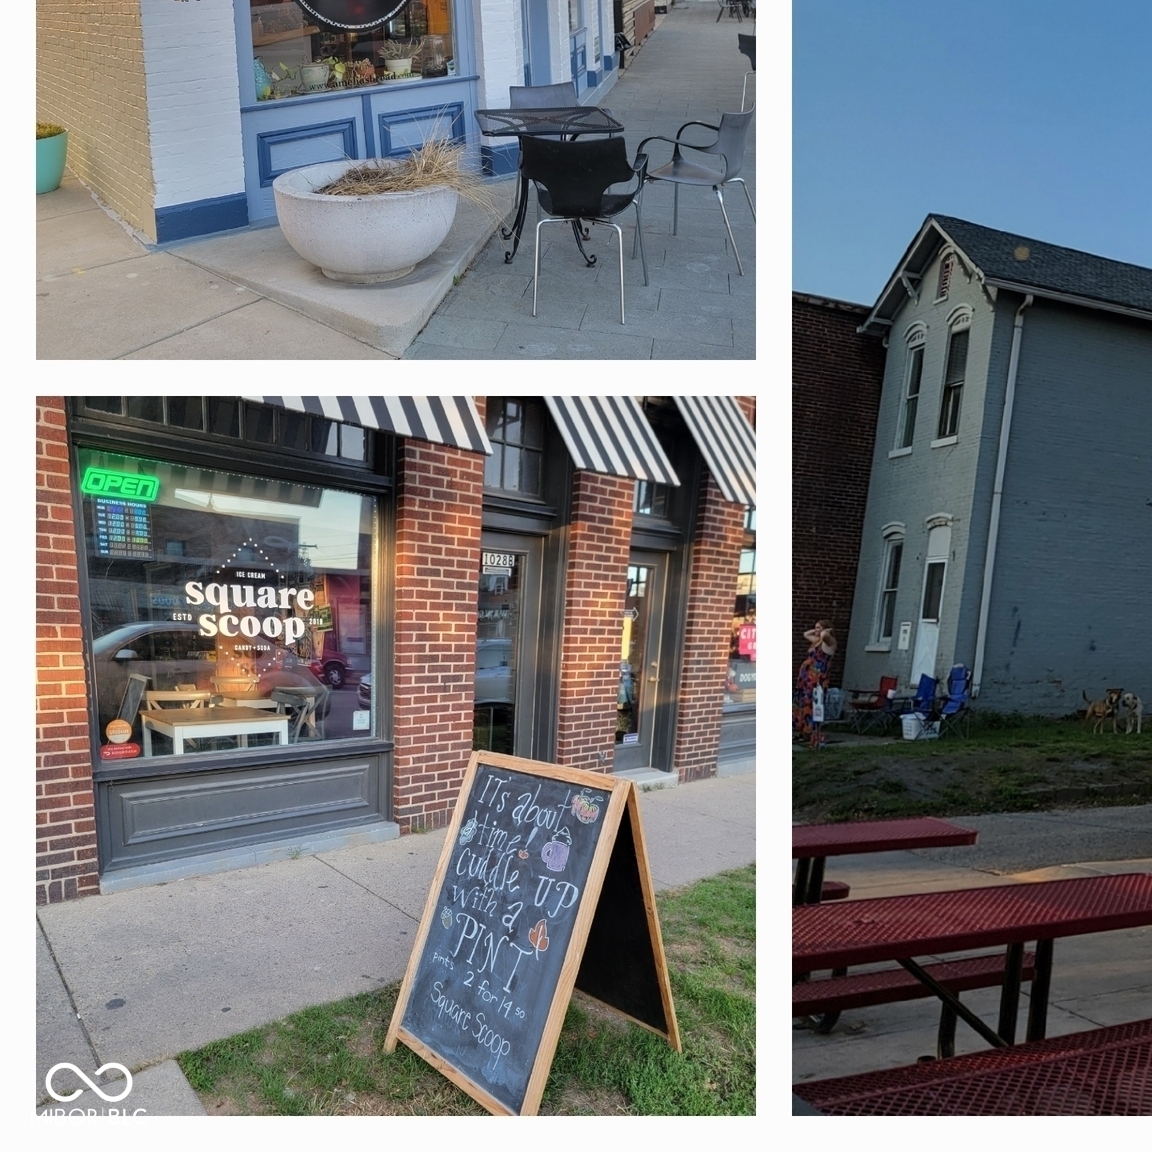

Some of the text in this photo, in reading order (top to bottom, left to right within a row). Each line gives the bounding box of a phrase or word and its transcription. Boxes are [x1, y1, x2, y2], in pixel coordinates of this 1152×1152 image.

[86, 473, 154, 497] OPEN
[247, 572, 266, 580] CREAM
[484, 553, 514, 566] 1028B
[185, 581, 315, 614] square
[172, 613, 192, 621] ESTD
[199, 613, 305, 646] scoop
[512, 784, 572, 833] about
[478, 813, 539, 854] time!
[534, 876, 579, 919] UP
[432, 951, 454, 970] pints
[450, 912, 533, 994] PINT
[463, 971, 475, 988] 2
[478, 980, 498, 1003] for
[430, 981, 511, 1070] Square Scoop
